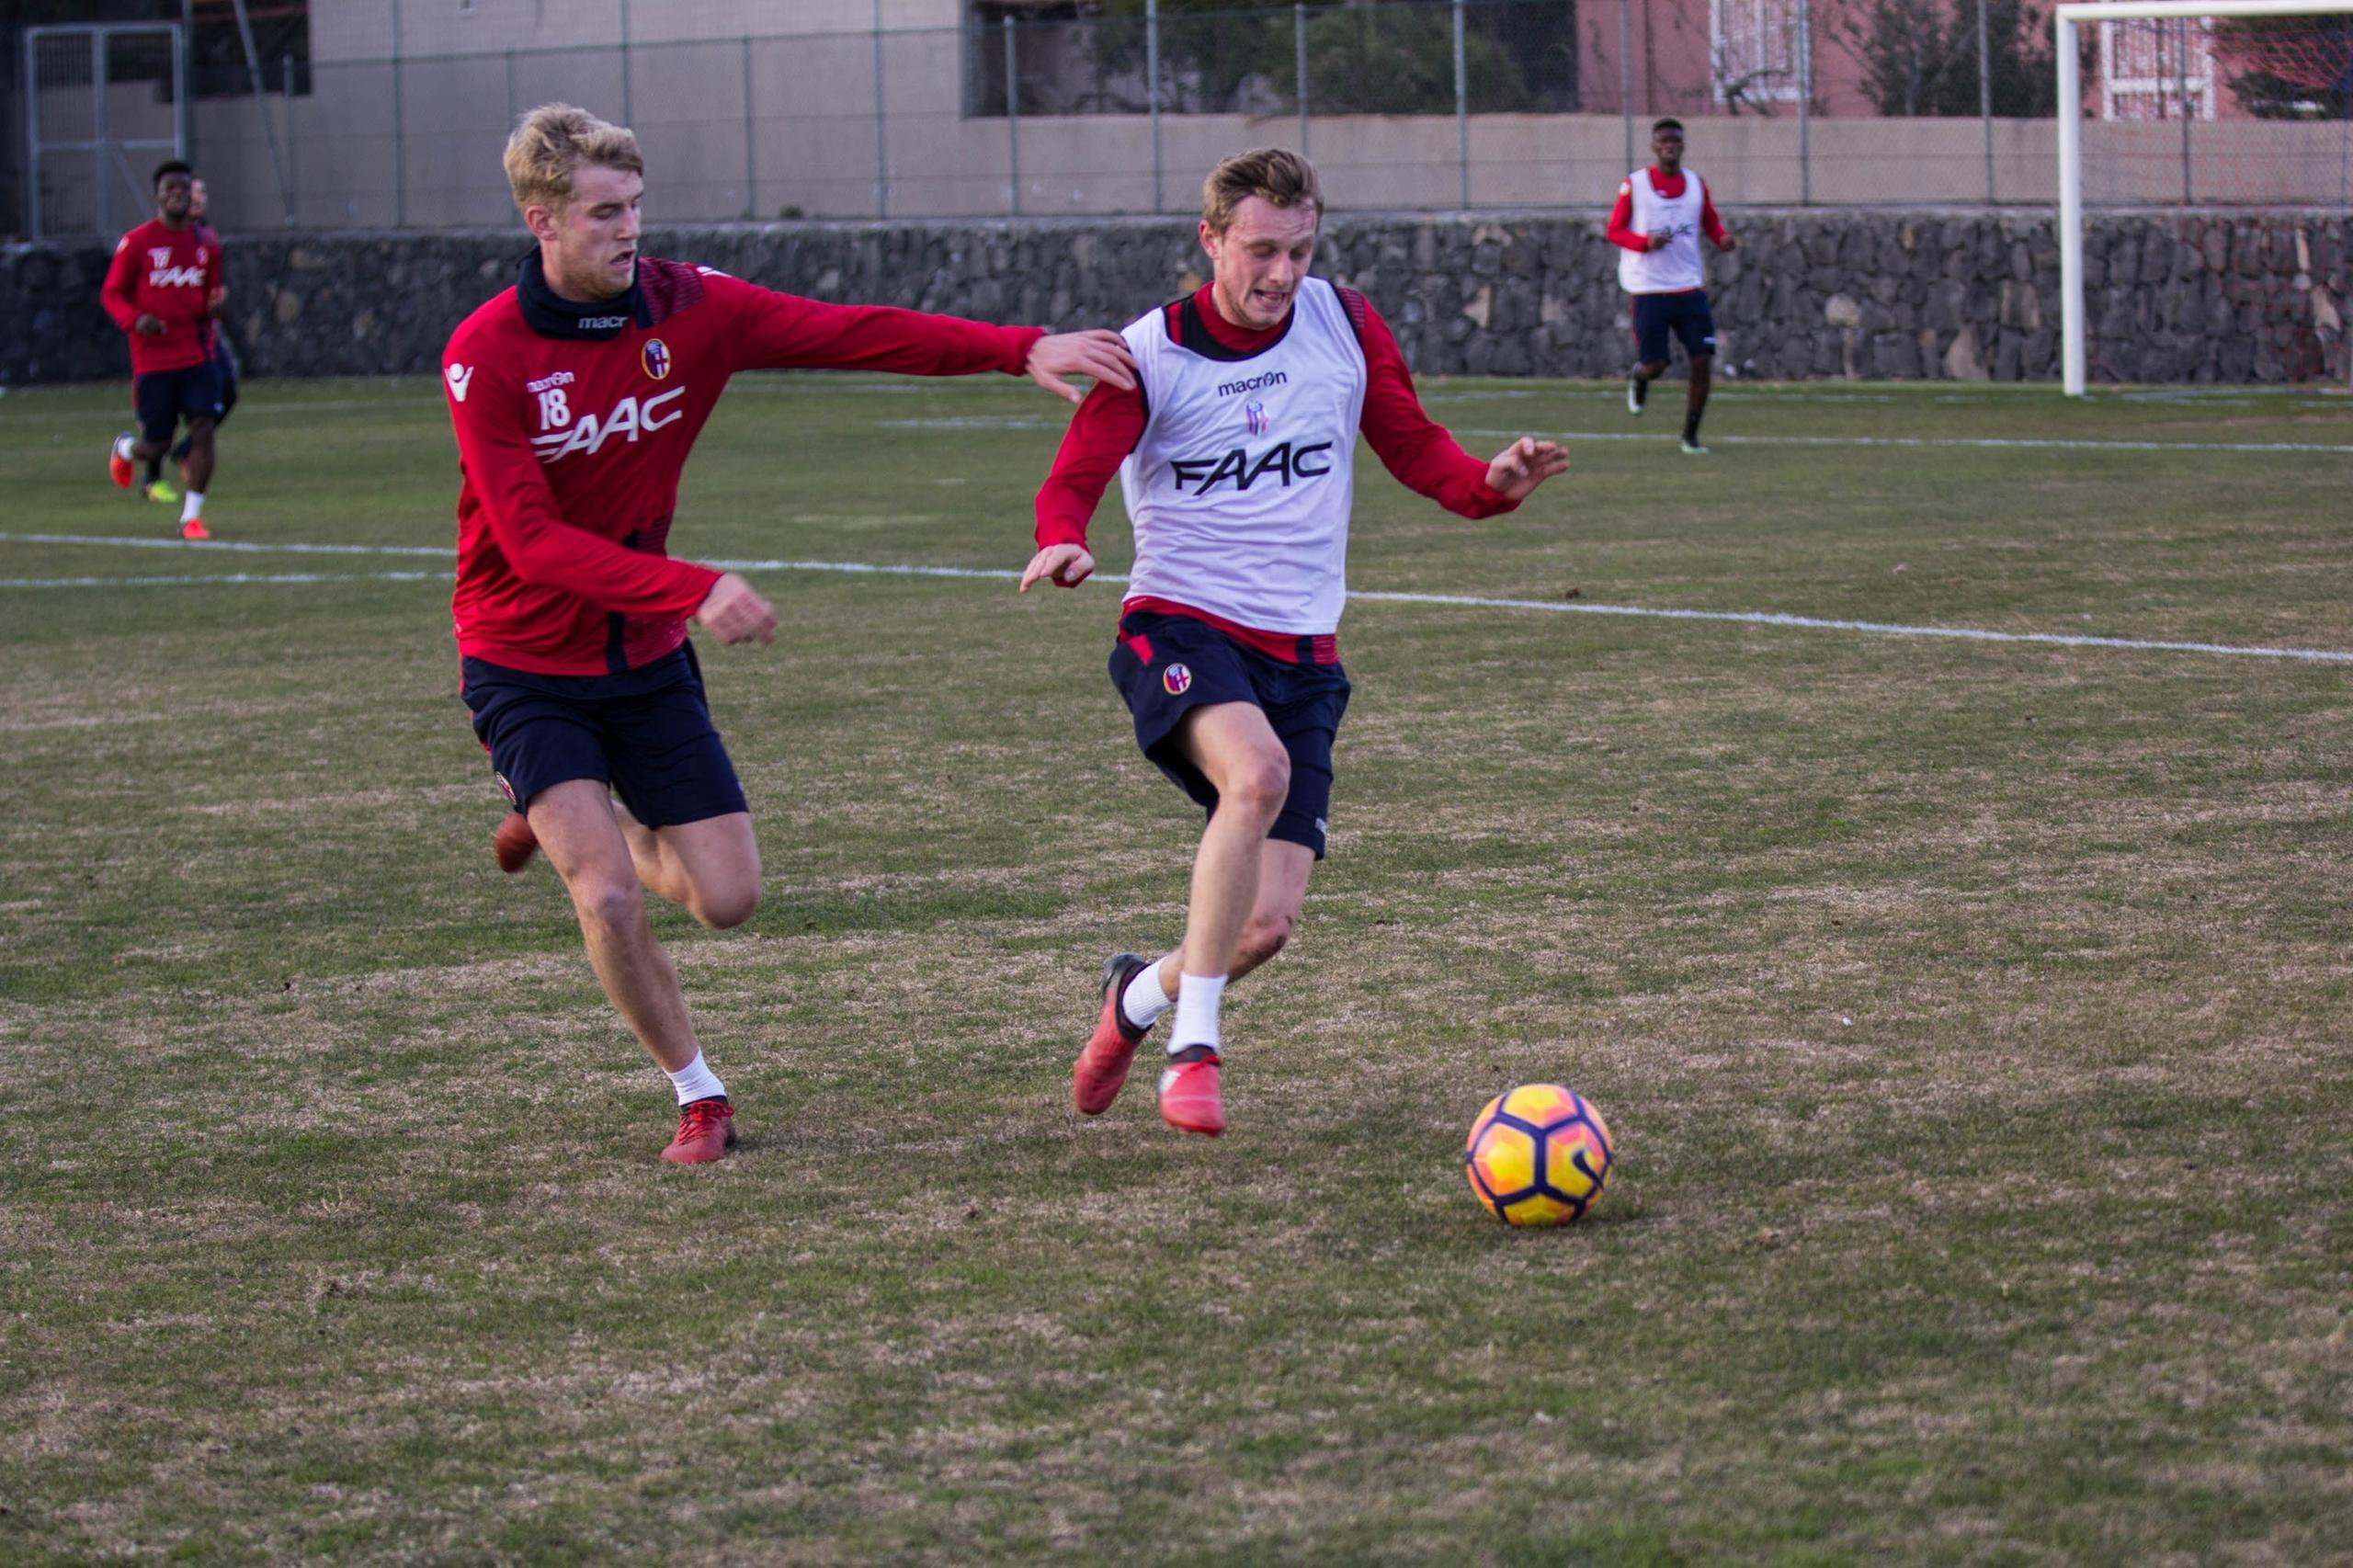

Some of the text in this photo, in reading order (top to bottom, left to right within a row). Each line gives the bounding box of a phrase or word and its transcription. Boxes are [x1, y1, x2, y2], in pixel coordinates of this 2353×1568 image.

[1218, 371, 1288, 397] macron
[538, 388, 571, 430] 18
[1170, 441, 1333, 496] FAAC
